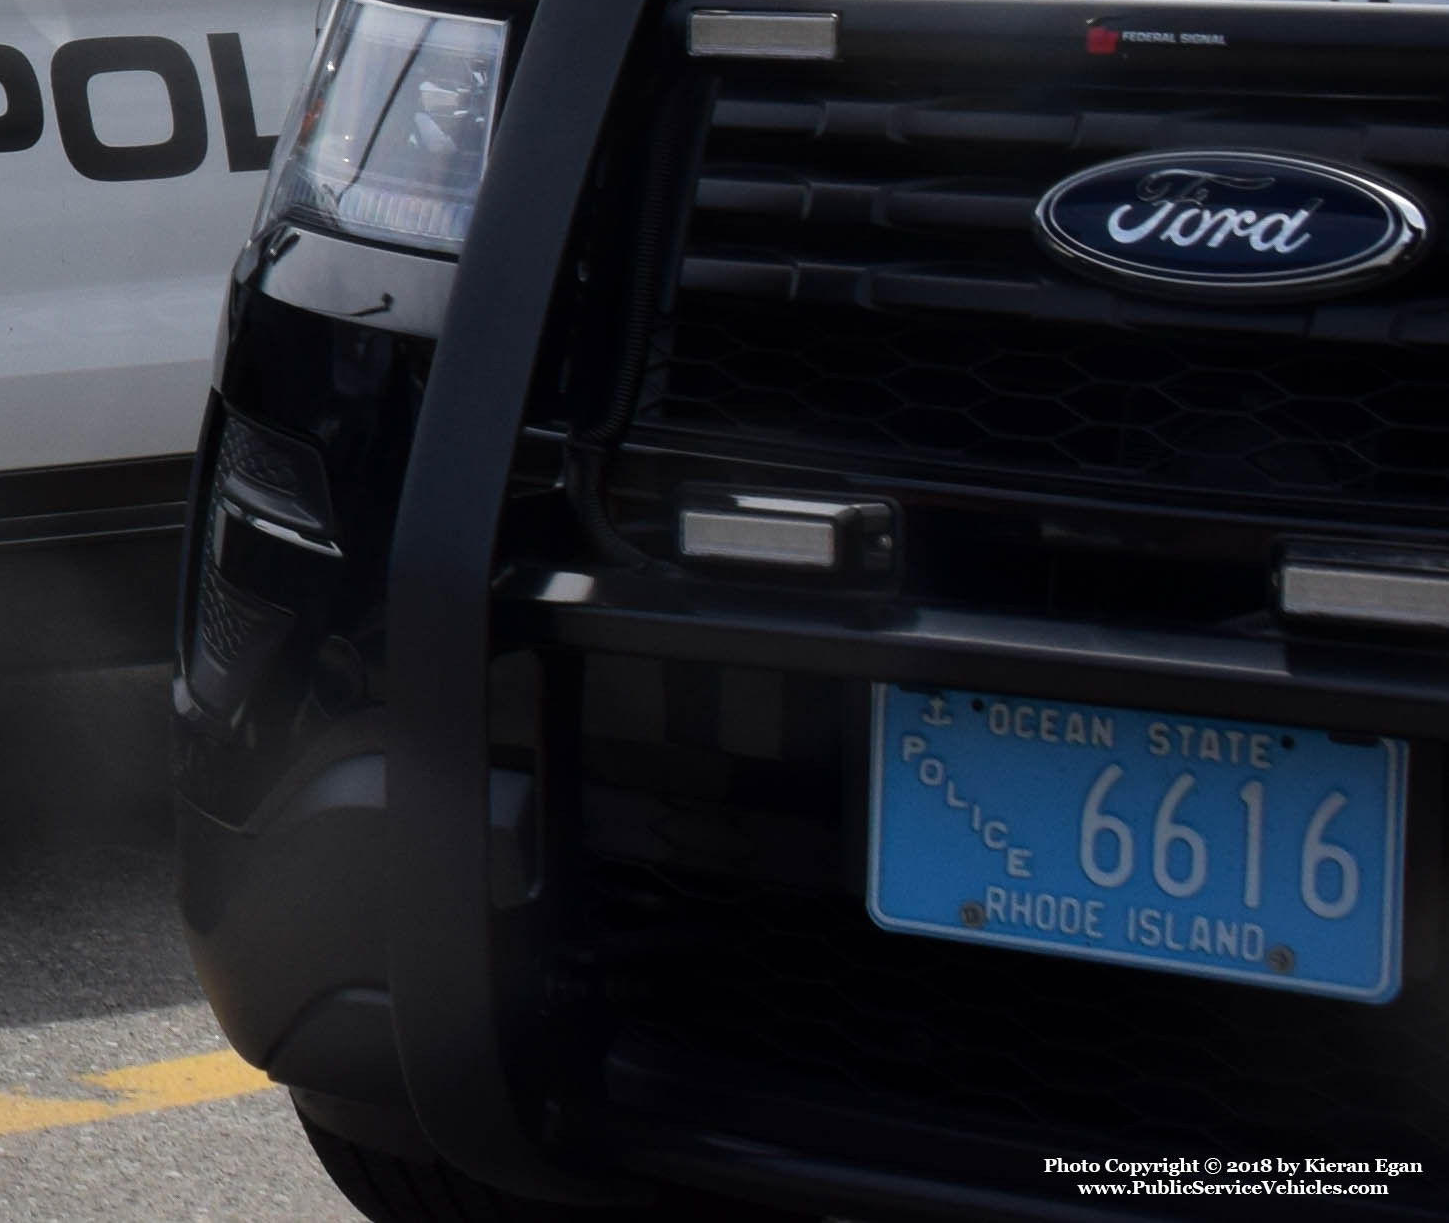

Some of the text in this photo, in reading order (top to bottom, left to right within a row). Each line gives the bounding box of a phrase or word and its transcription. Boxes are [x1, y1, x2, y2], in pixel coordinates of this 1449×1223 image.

[1122, 30, 1227, 46] FEDERAL SIGNAL
[1107, 168, 1325, 254] Ford
[987, 703, 1273, 770] OCEAN STATE
[901, 735, 1033, 878] POLICE
[1079, 762, 1359, 919] 6616
[986, 886, 1265, 963] RHODE ISLAND
